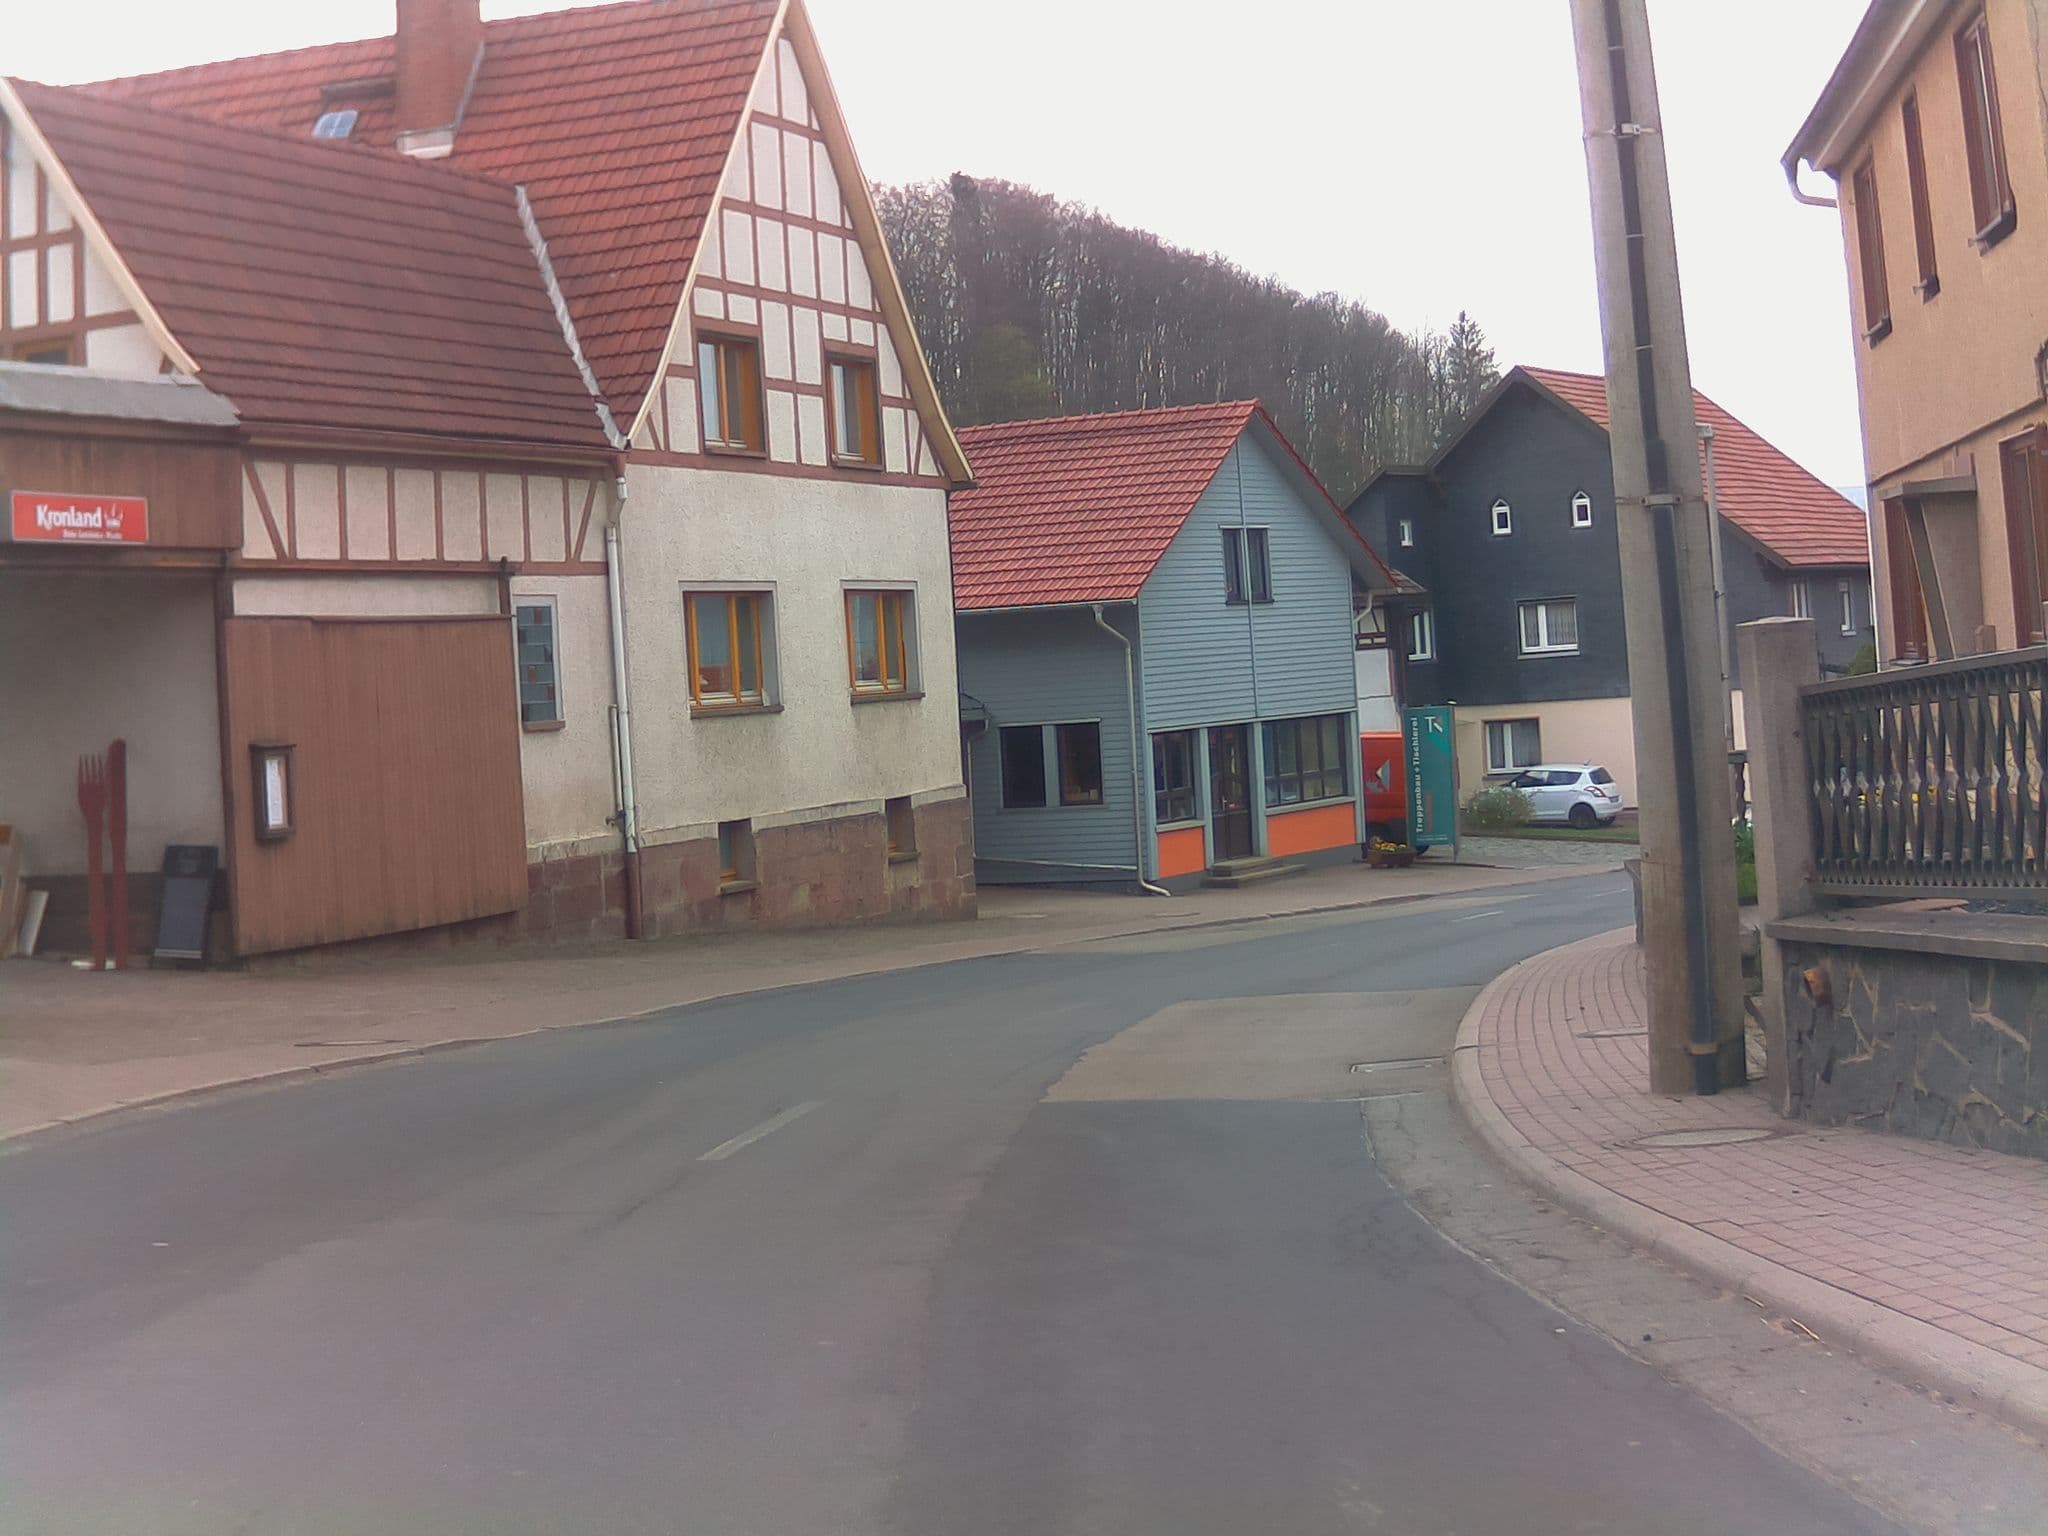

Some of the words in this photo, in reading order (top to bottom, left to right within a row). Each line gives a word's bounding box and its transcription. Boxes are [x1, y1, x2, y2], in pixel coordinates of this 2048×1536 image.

[36, 503, 102, 530] Kronland
[1411, 717, 1420, 765] Tischlerei
[1414, 774, 1424, 833] Treppenbau
